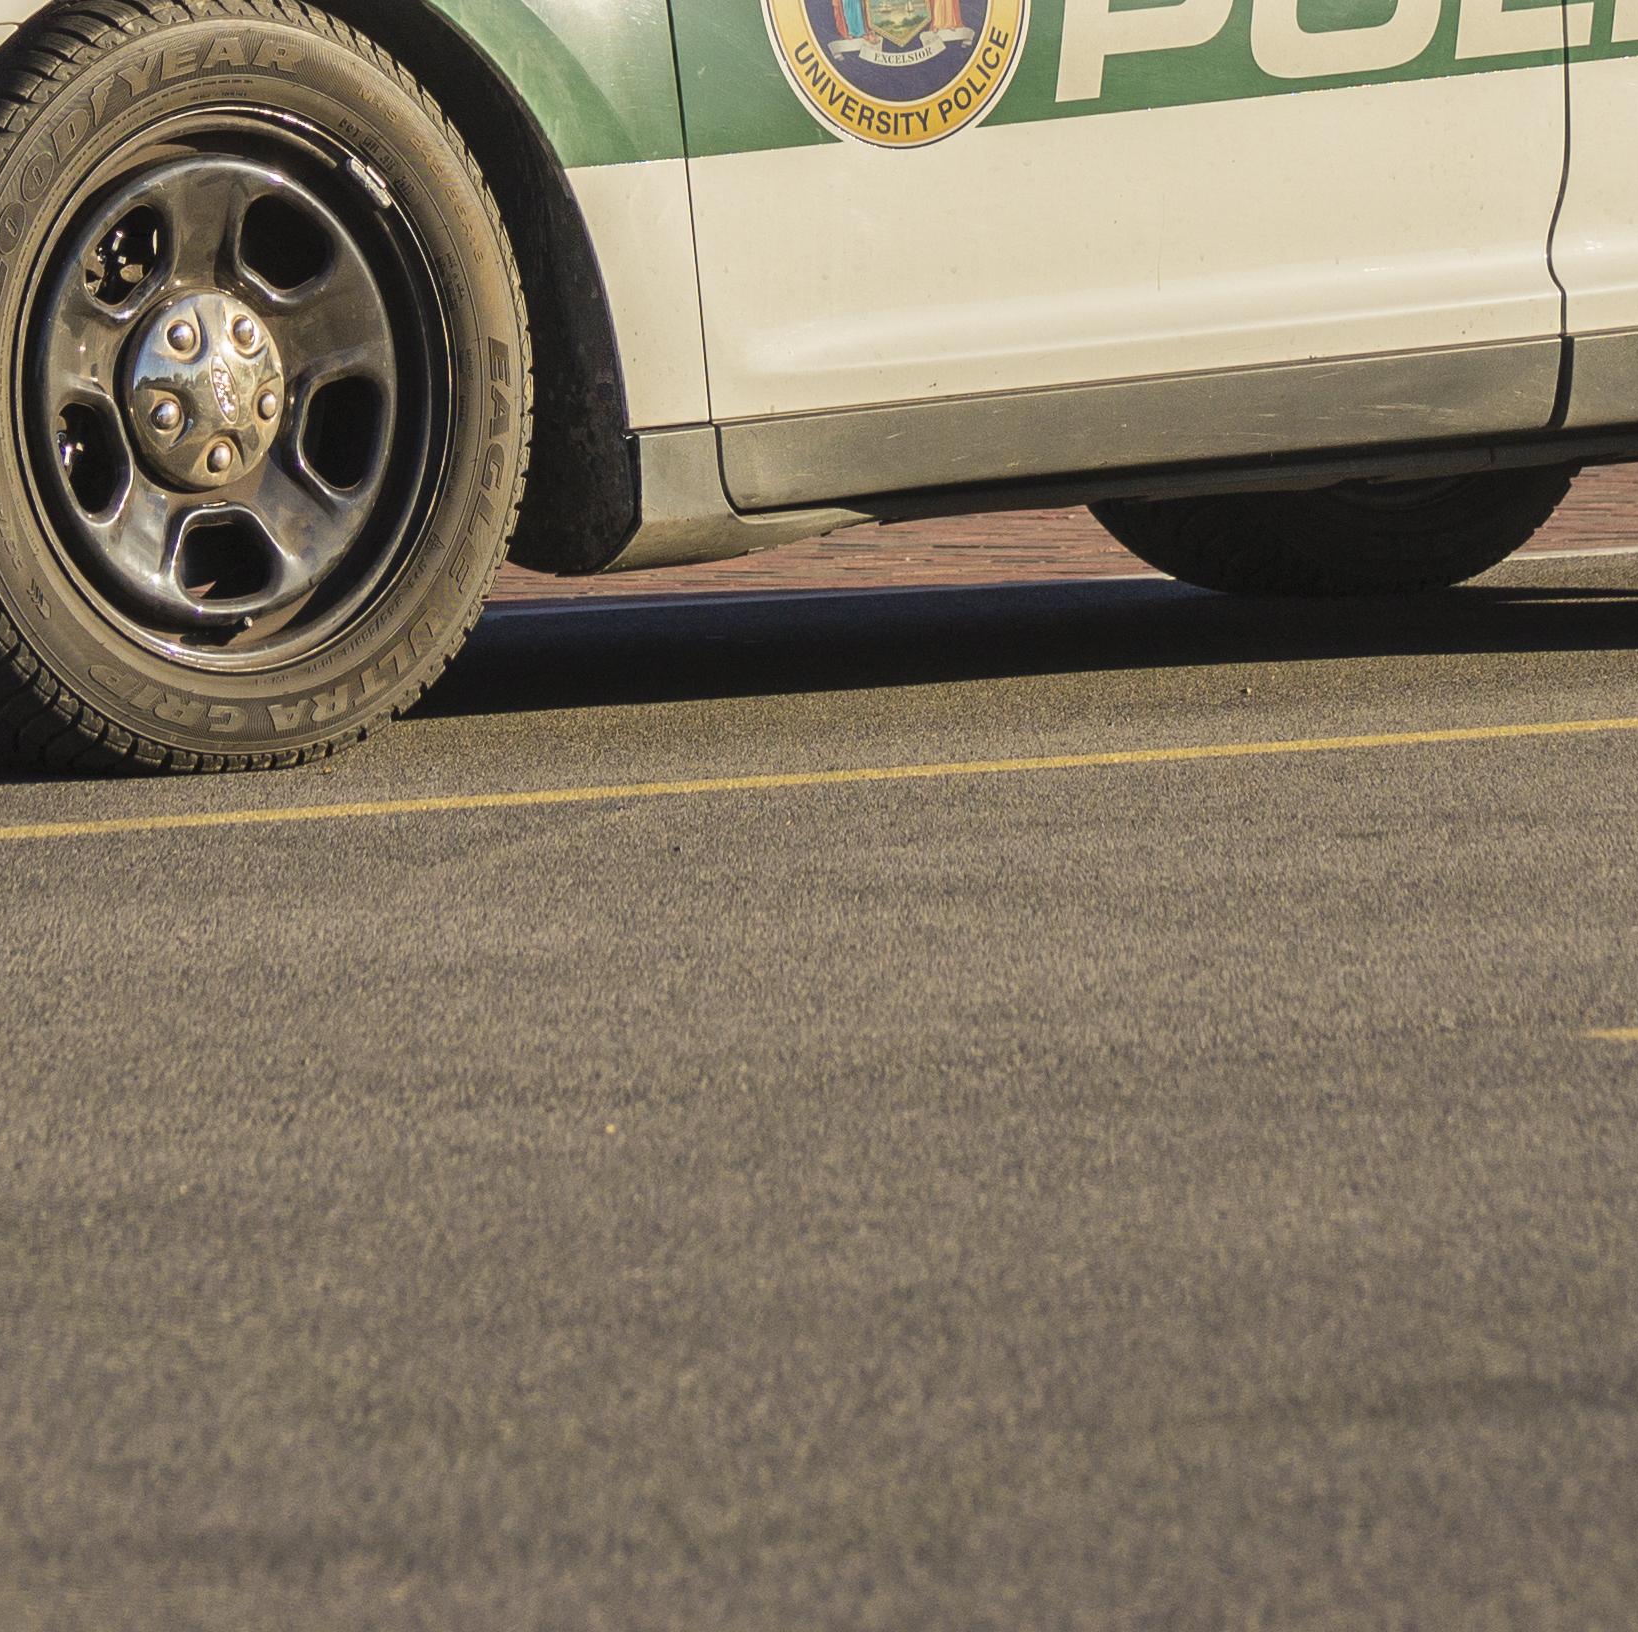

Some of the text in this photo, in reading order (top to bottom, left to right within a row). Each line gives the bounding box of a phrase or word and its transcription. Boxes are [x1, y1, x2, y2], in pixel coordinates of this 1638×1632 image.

[794, 26, 1009, 136] UNIVERSITY POLICE
[873, 46, 933, 65] EXCELSIOR
[448, 335, 512, 595] EAGLE
[87, 664, 247, 734] GRIP
[266, 606, 444, 733] ULTRA
